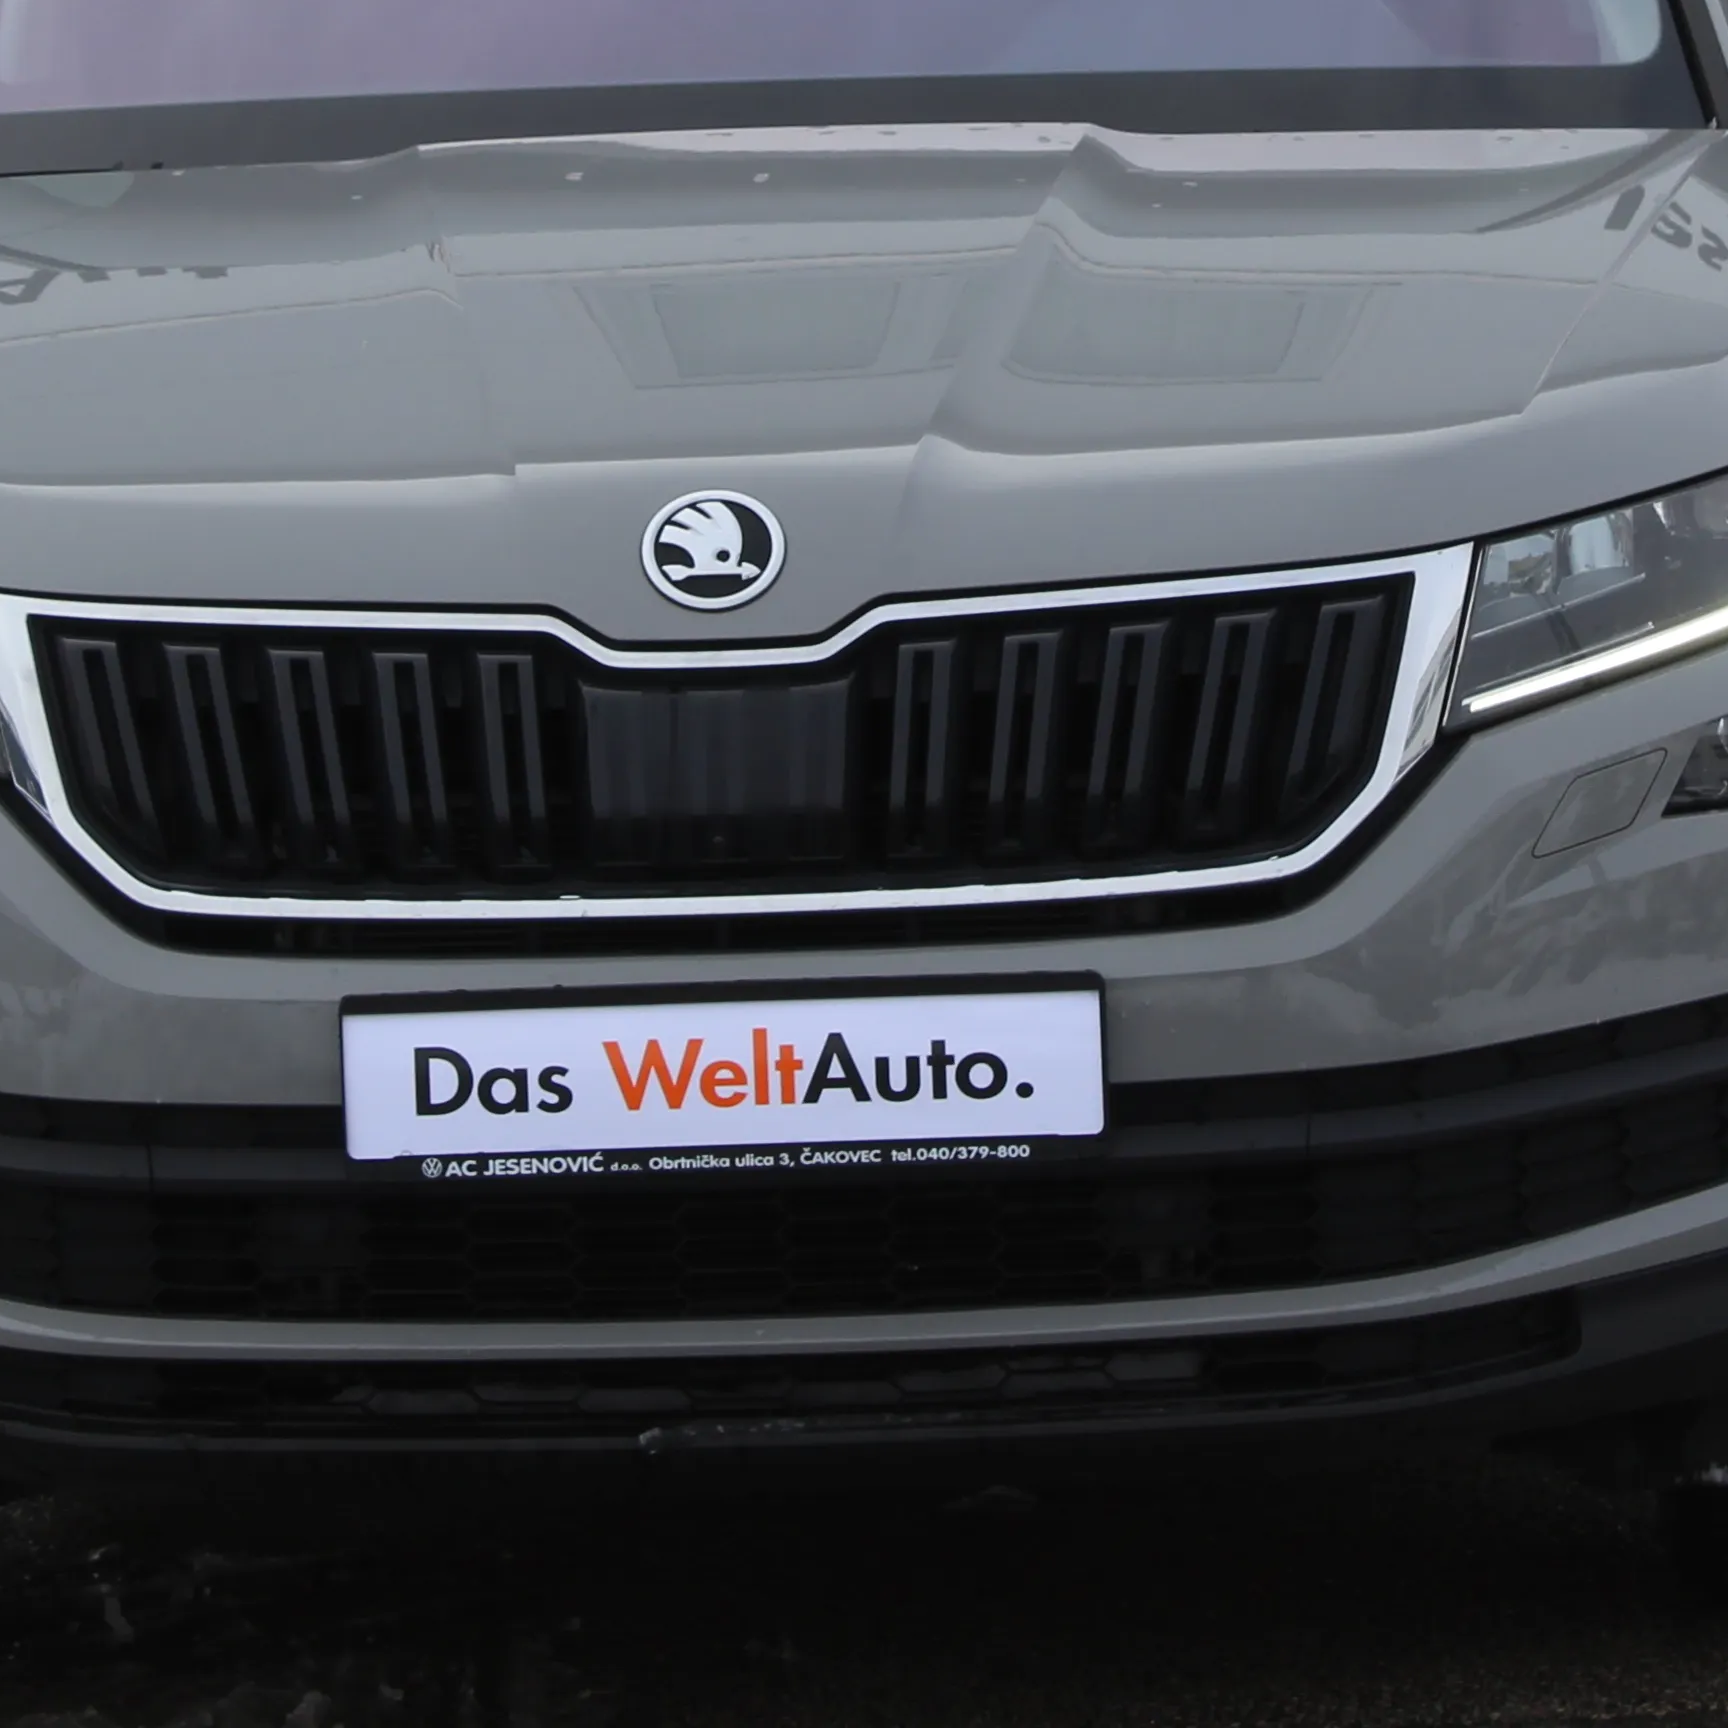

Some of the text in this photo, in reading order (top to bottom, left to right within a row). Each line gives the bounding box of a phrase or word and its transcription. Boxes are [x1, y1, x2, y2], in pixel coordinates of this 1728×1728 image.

[414, 1028, 1035, 1116] Das WeltAuto.
[445, 1160, 477, 1177] AC
[483, 1151, 604, 1176] JESENOVIĆ
[648, 1154, 731, 1171] Obrtnička
[734, 1153, 775, 1168] ulica
[779, 1152, 795, 1168] 3,
[799, 1147, 882, 1166] ČAKOVEC
[890, 1144, 1031, 1162] tel.040/379-800
